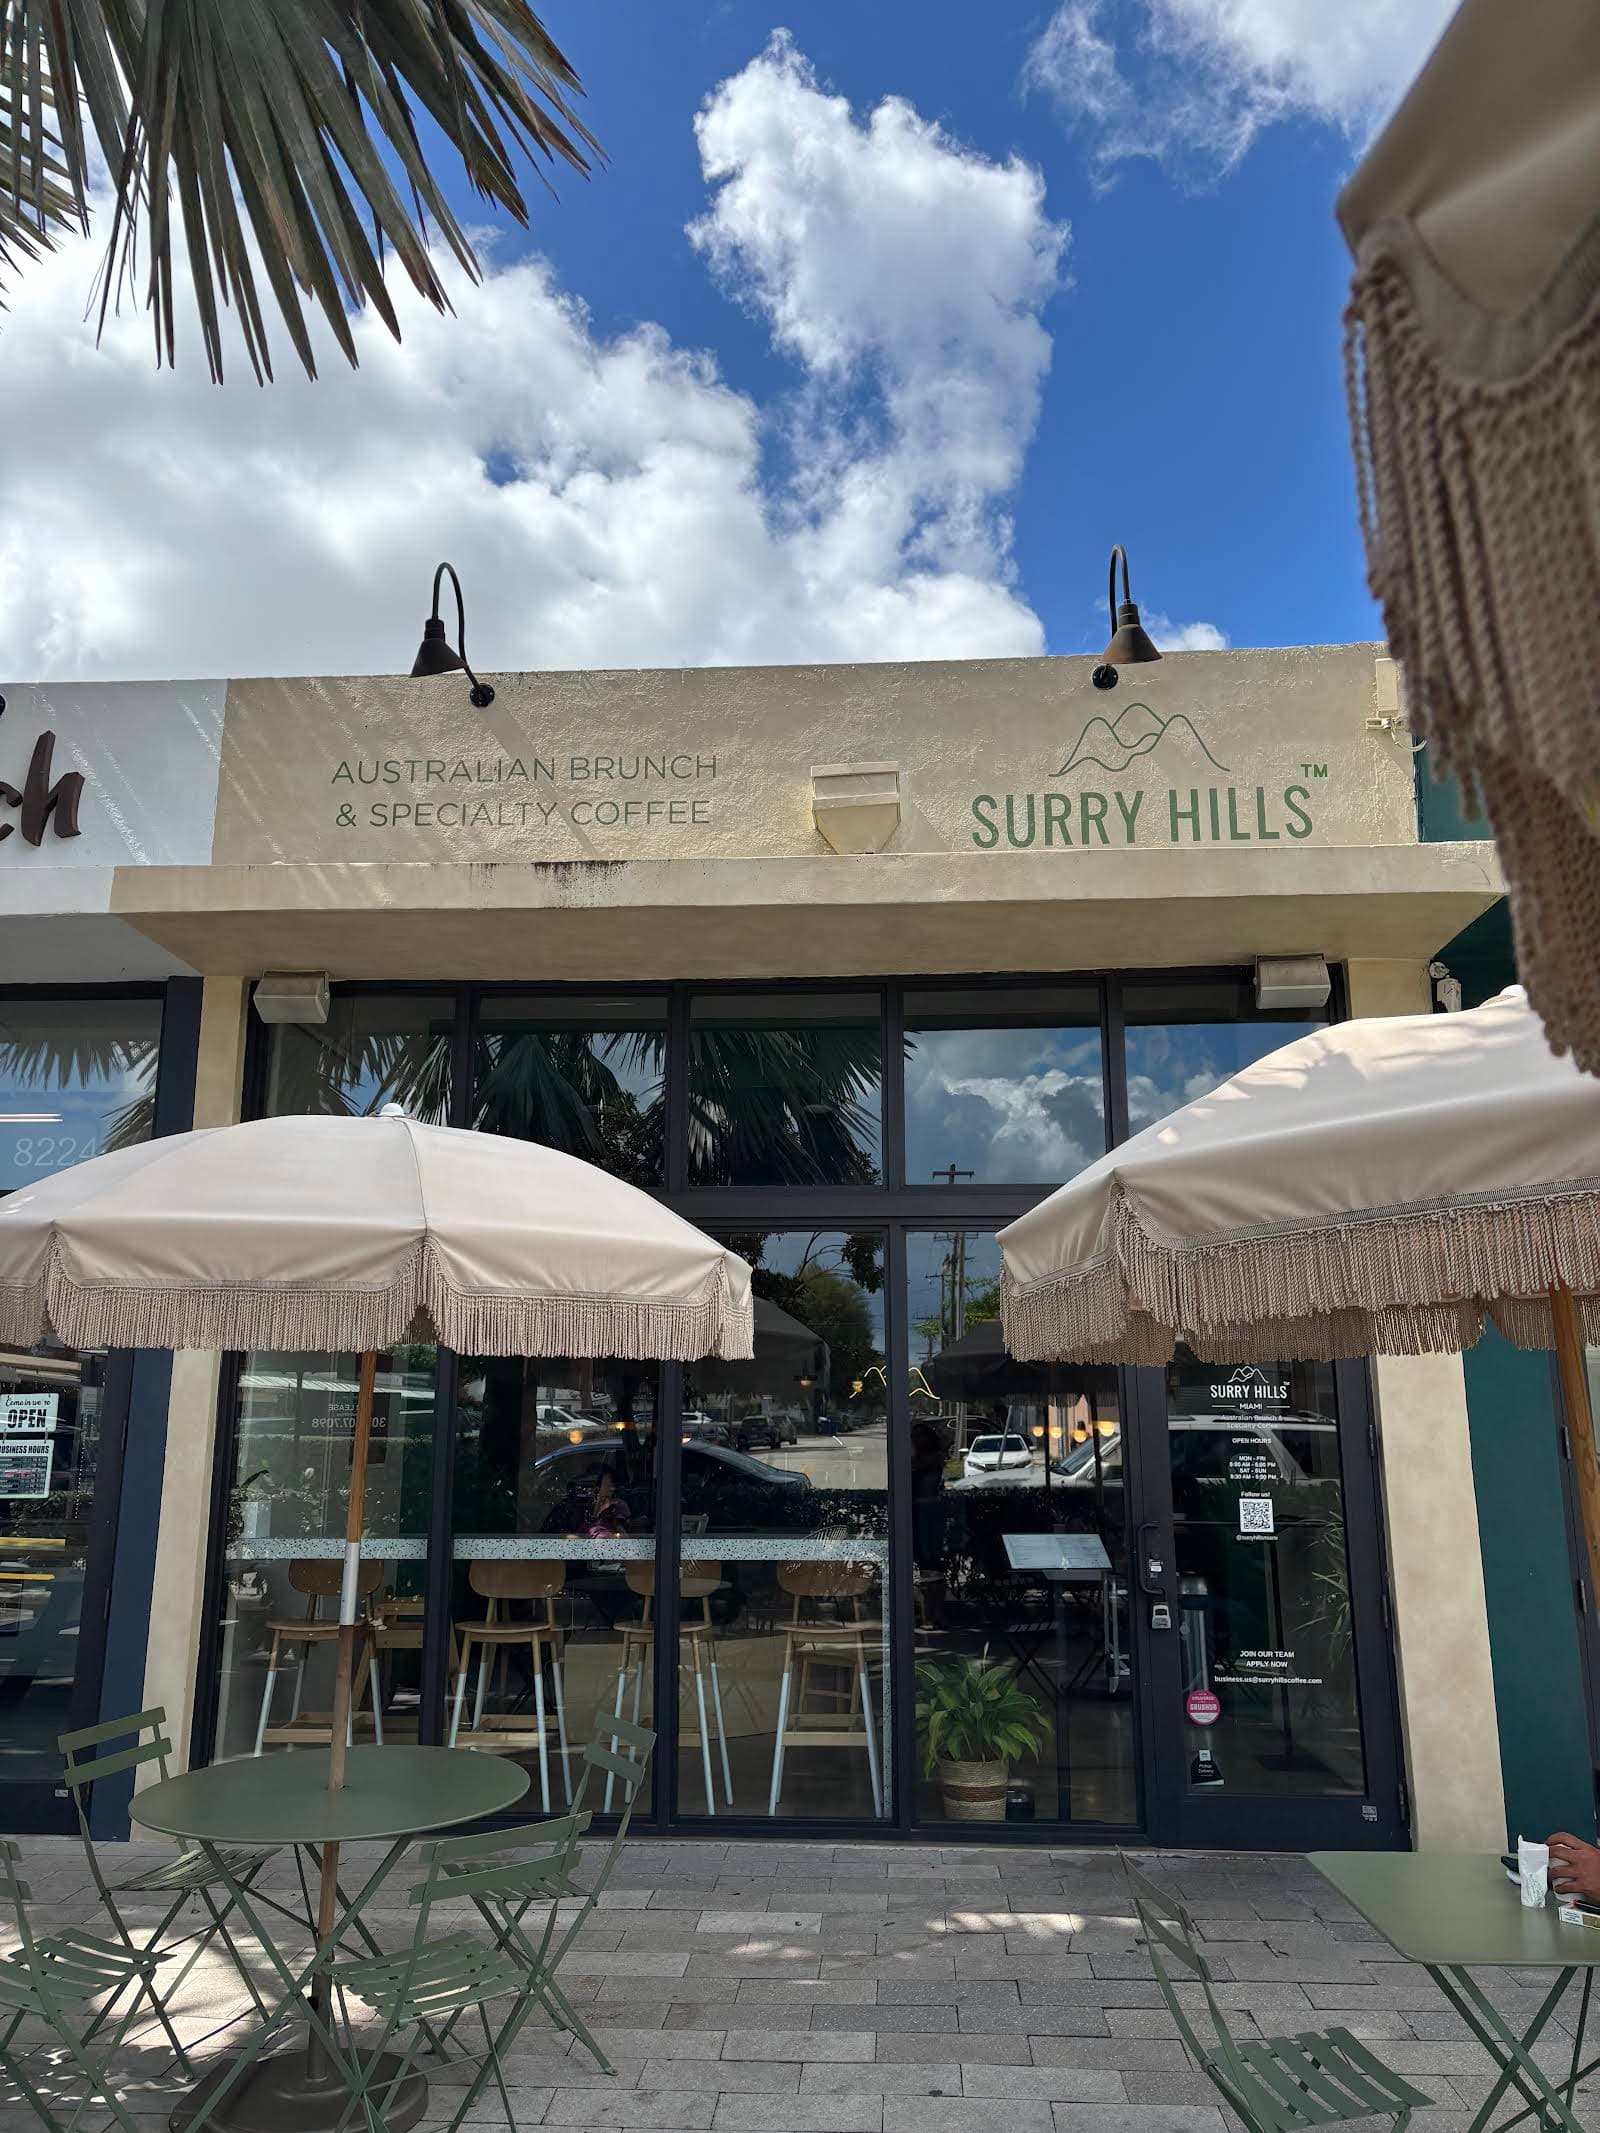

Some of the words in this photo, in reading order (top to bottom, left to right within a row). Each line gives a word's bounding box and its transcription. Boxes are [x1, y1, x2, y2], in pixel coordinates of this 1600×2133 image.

[331, 758, 555, 784] AUSTRALIAN
[570, 755, 717, 781] BRUNCH
[335, 803, 358, 827] &
[369, 802, 558, 827] SPECIALTY
[570, 800, 710, 826] COFFEE
[971, 790, 1145, 849] SURRY
[1169, 785, 1313, 844] HILLS
[1210, 1384, 1250, 1398] SURRY
[1254, 1385, 1288, 1399] HILLS
[8, 1409, 47, 1428] OPEN
[28, 1445, 49, 1454] HOURS
[1240, 1650, 1256, 1658] JOIN
[1274, 1651, 1294, 1659] TEAM
[1246, 1660, 1269, 1668] APPLY
